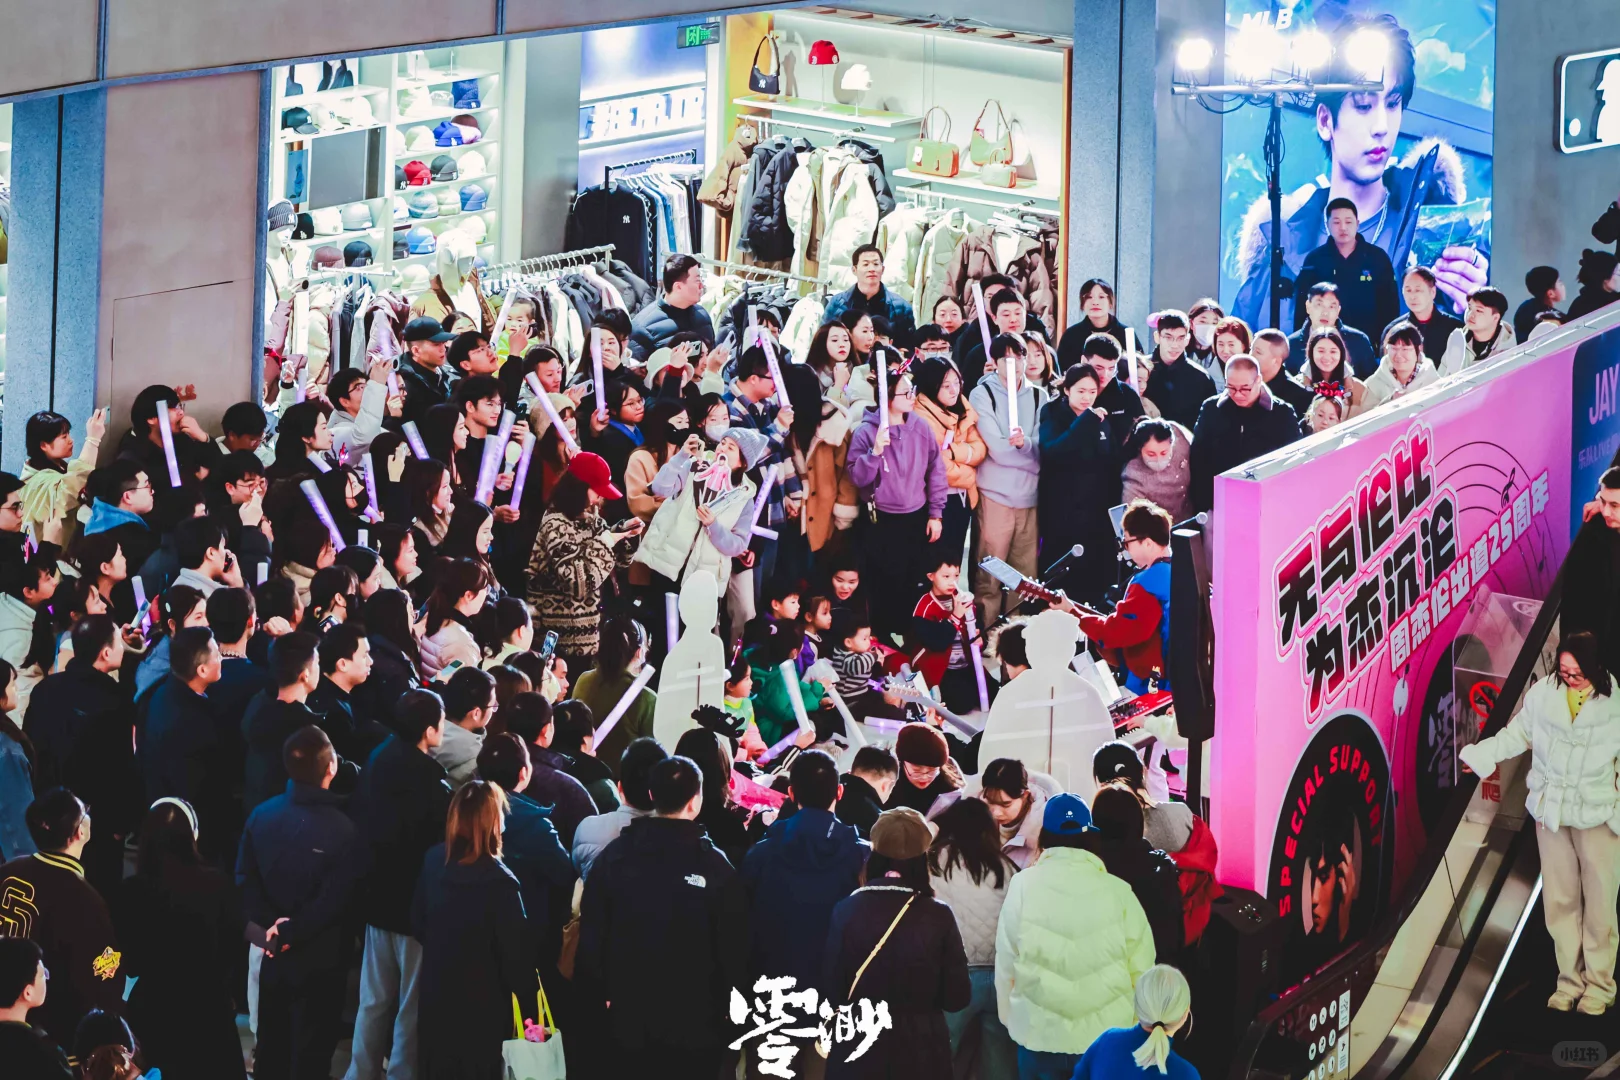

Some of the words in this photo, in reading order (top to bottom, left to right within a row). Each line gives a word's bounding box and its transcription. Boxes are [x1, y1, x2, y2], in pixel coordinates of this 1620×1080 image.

[1240, 8, 1293, 31] MLB
[1589, 363, 1620, 425] JAY
[1276, 430, 1433, 652] 无与伦比
[1390, 470, 1550, 673] 周杰伦出道25周年
[1279, 765, 1325, 918] SPECIAL
[1329, 744, 1382, 847] SUPPORT
